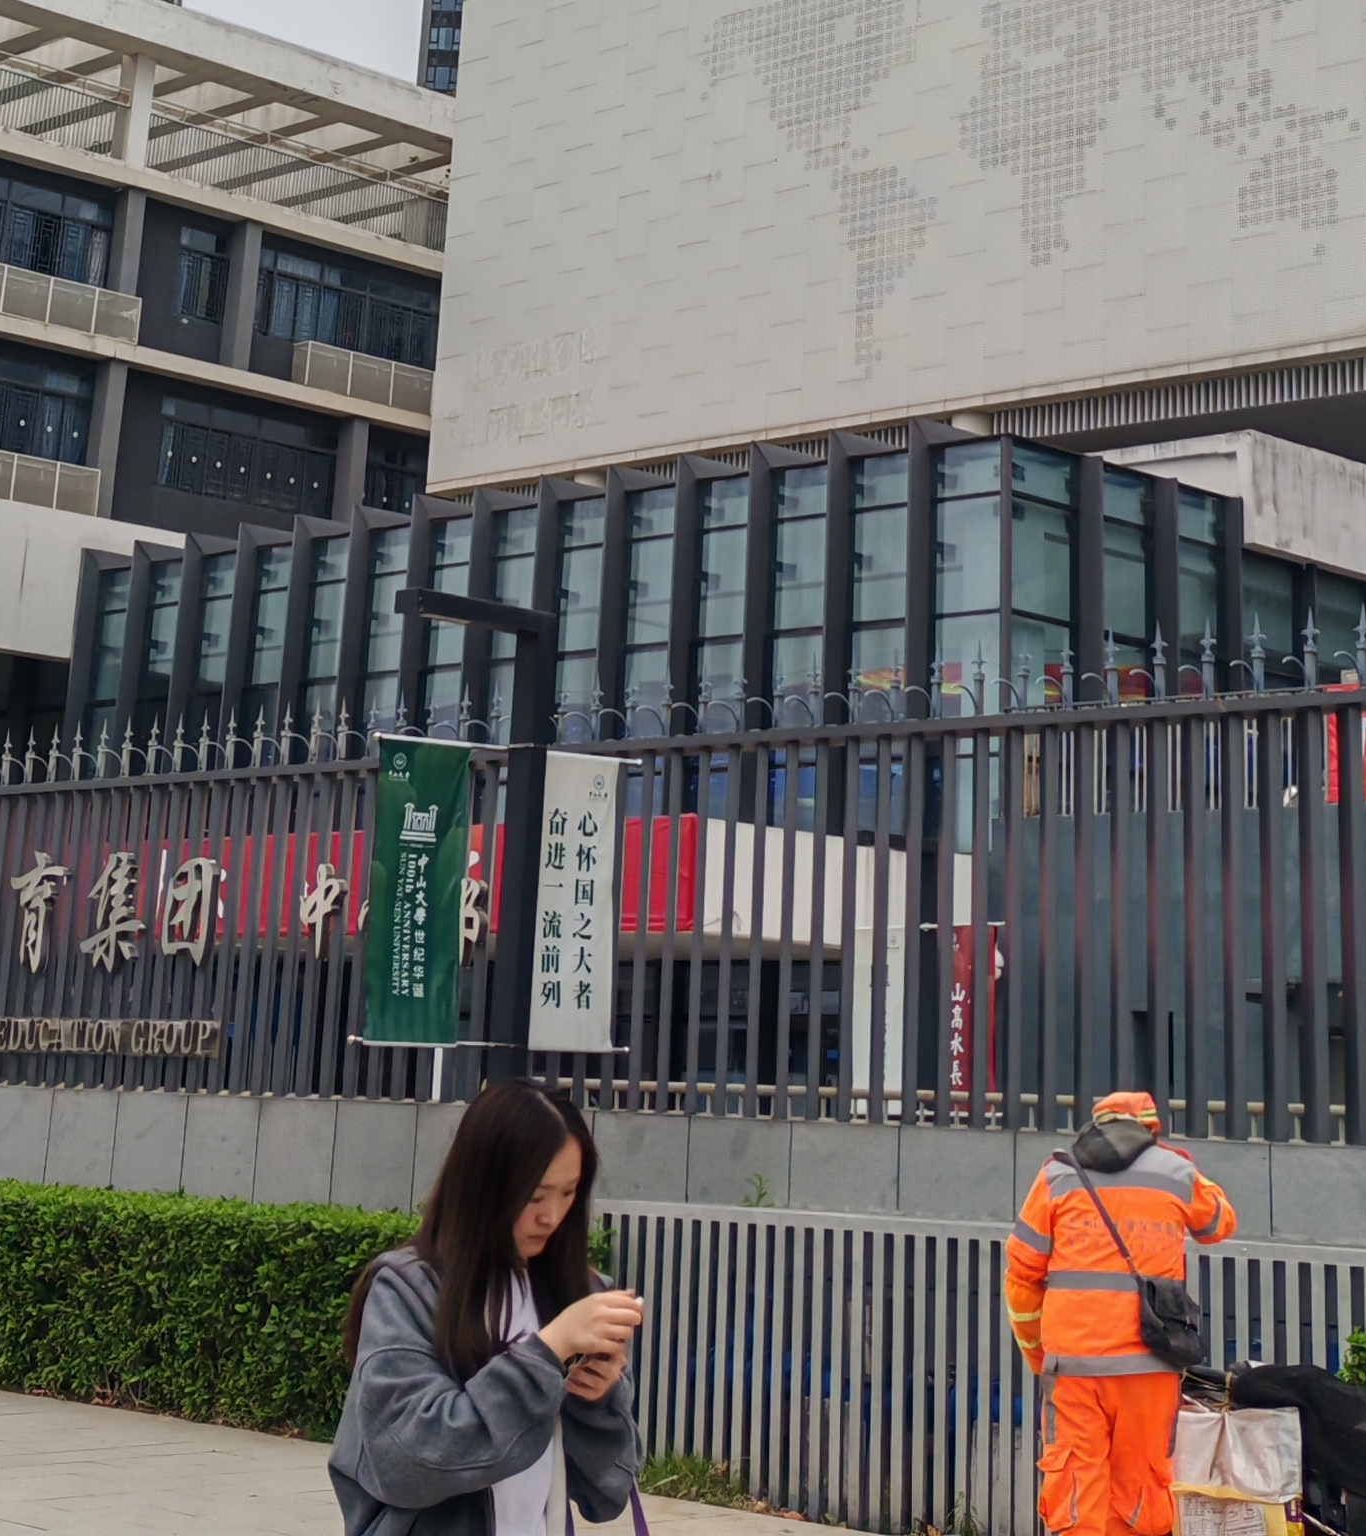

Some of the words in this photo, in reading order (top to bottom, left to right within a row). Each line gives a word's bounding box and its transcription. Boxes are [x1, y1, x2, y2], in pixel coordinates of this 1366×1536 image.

[398, 852, 407, 875] SUN
[405, 853, 418, 894] 100th
[392, 878, 404, 923] YAT-SEN
[540, 808, 568, 1009] 奋进一流前列
[572, 810, 598, 1011] 心怀国之大者
[391, 927, 401, 997] UNIVERSITY
[401, 900, 412, 997] ANNIVERSARY
[130, 1020, 212, 1054] GROUP
